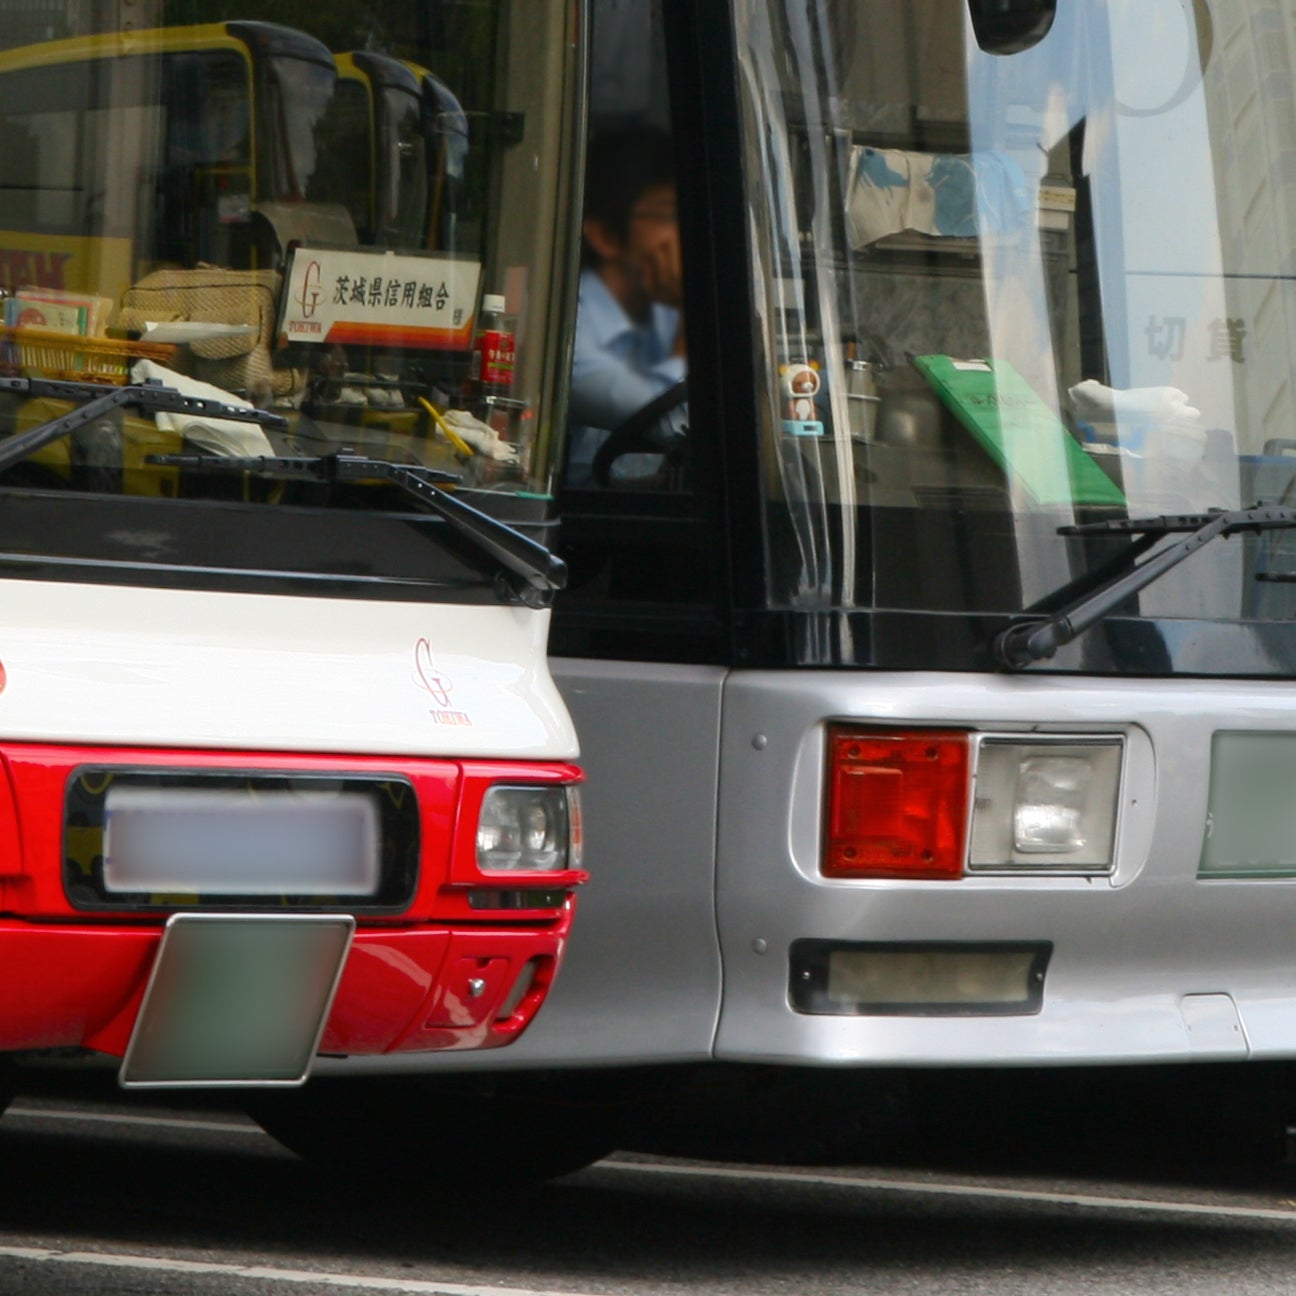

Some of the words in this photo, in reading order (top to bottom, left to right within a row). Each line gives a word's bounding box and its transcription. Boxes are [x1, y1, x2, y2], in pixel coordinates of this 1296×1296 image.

[332, 274, 451, 311] 茨城県信用組合
